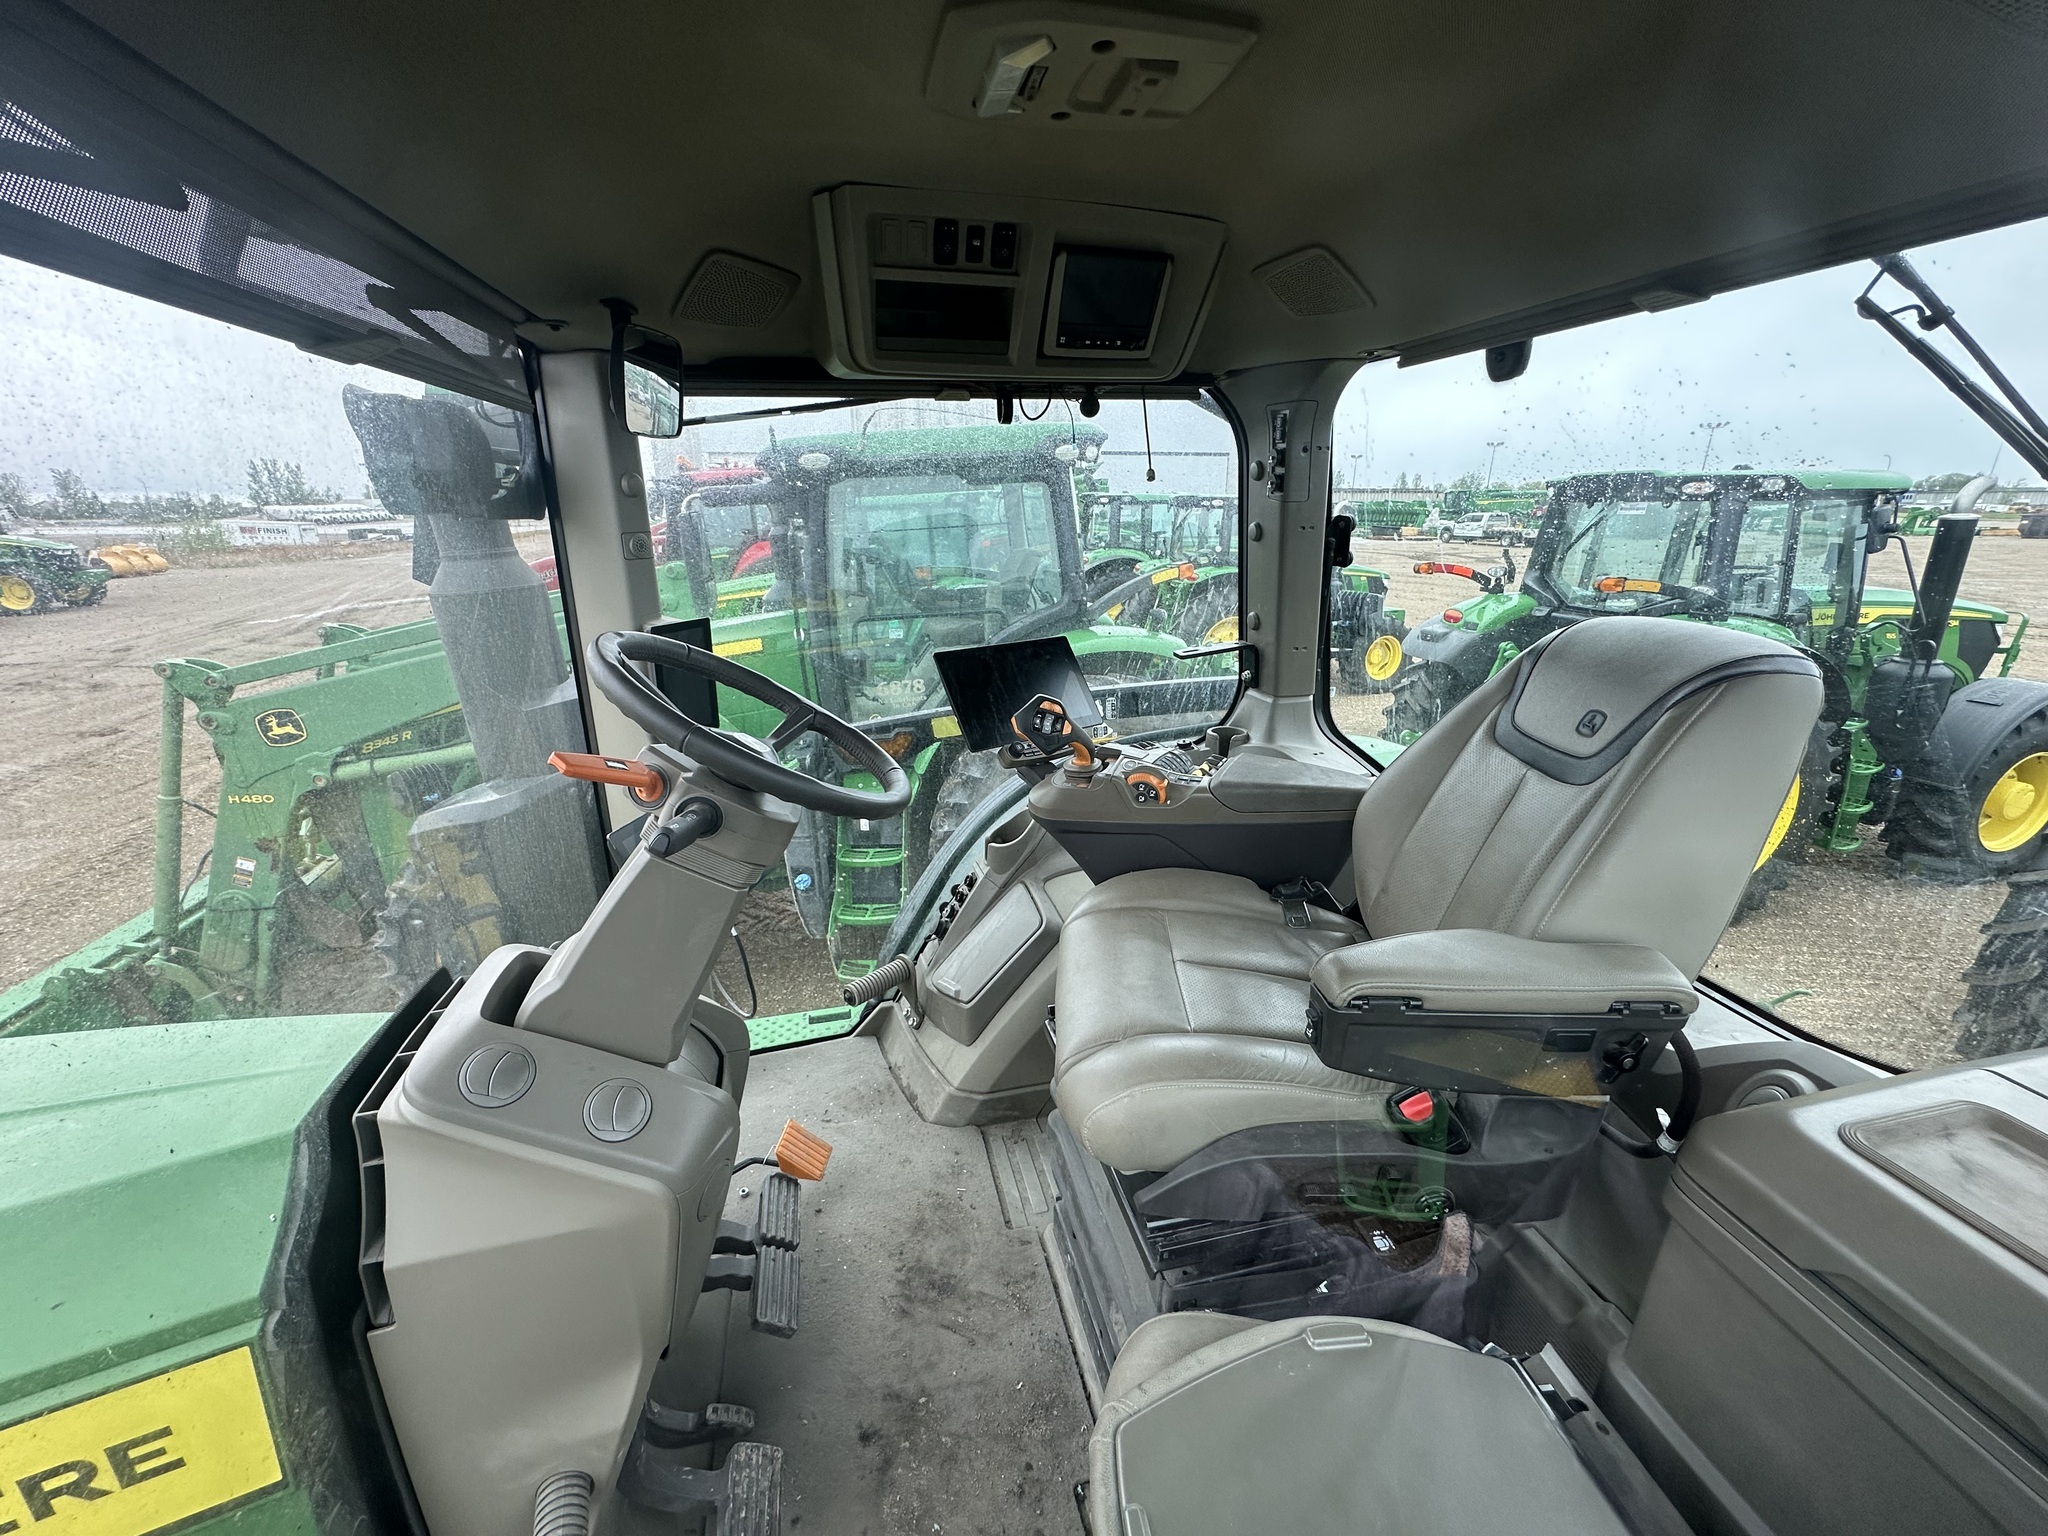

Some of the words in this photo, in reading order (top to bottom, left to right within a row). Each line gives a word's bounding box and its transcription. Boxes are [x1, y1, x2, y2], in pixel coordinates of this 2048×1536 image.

[257, 527, 288, 535] FINISH
[1815, 612, 1833, 621] JOH
[362, 734, 399, 753] 8345
[402, 730, 412, 741] R
[228, 794, 275, 804] H480
